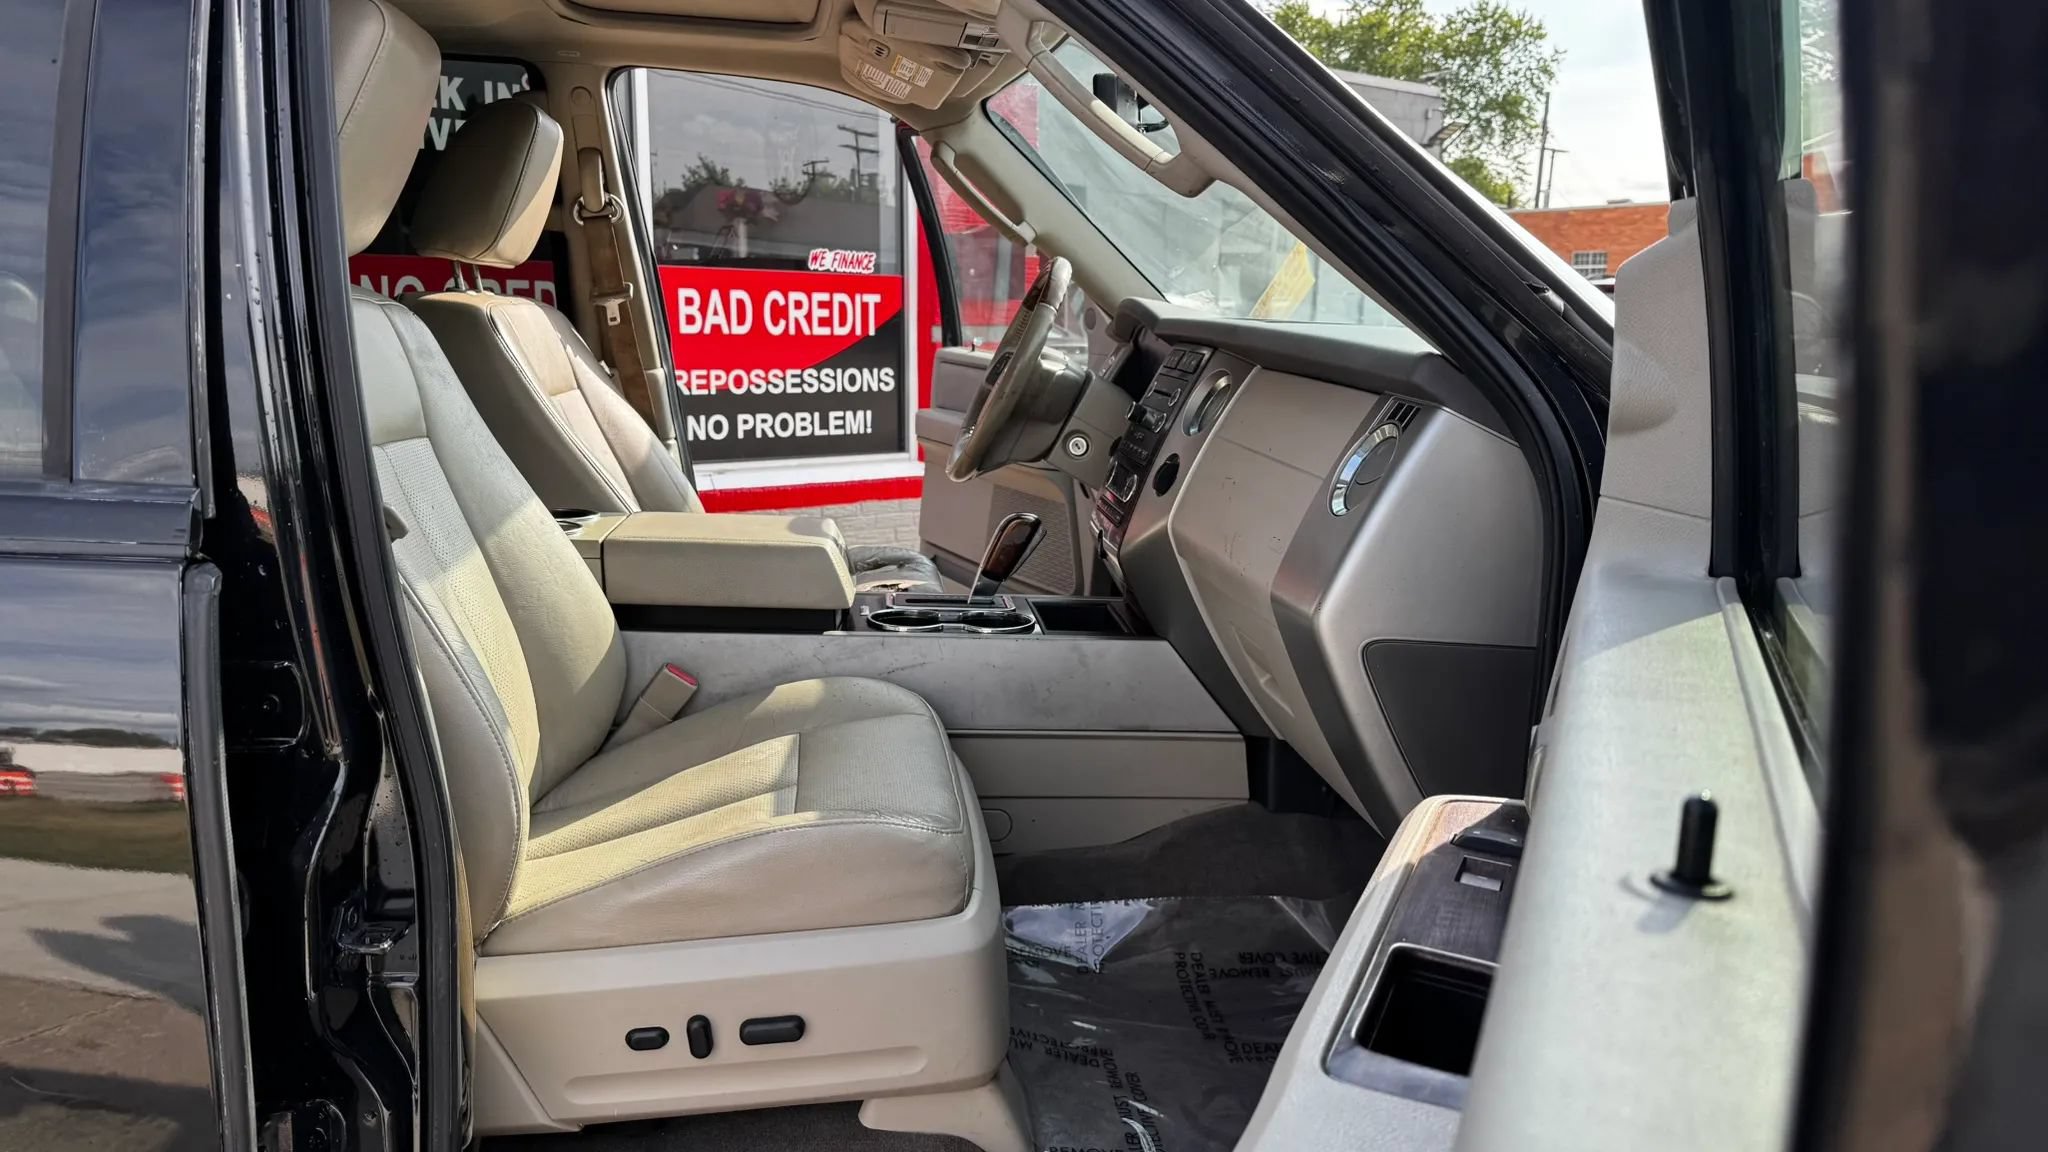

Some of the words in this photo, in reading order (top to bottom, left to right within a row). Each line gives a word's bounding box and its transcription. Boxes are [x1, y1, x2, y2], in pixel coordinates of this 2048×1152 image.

[809, 250, 828, 268] WE
[831, 251, 876, 271] FINANCE
[677, 288, 754, 335] BAD
[763, 290, 881, 336] CREDIT
[676, 367, 895, 396] REPOSSESSIONS
[687, 414, 730, 441] NO
[737, 409, 873, 440] PROBLEM!
